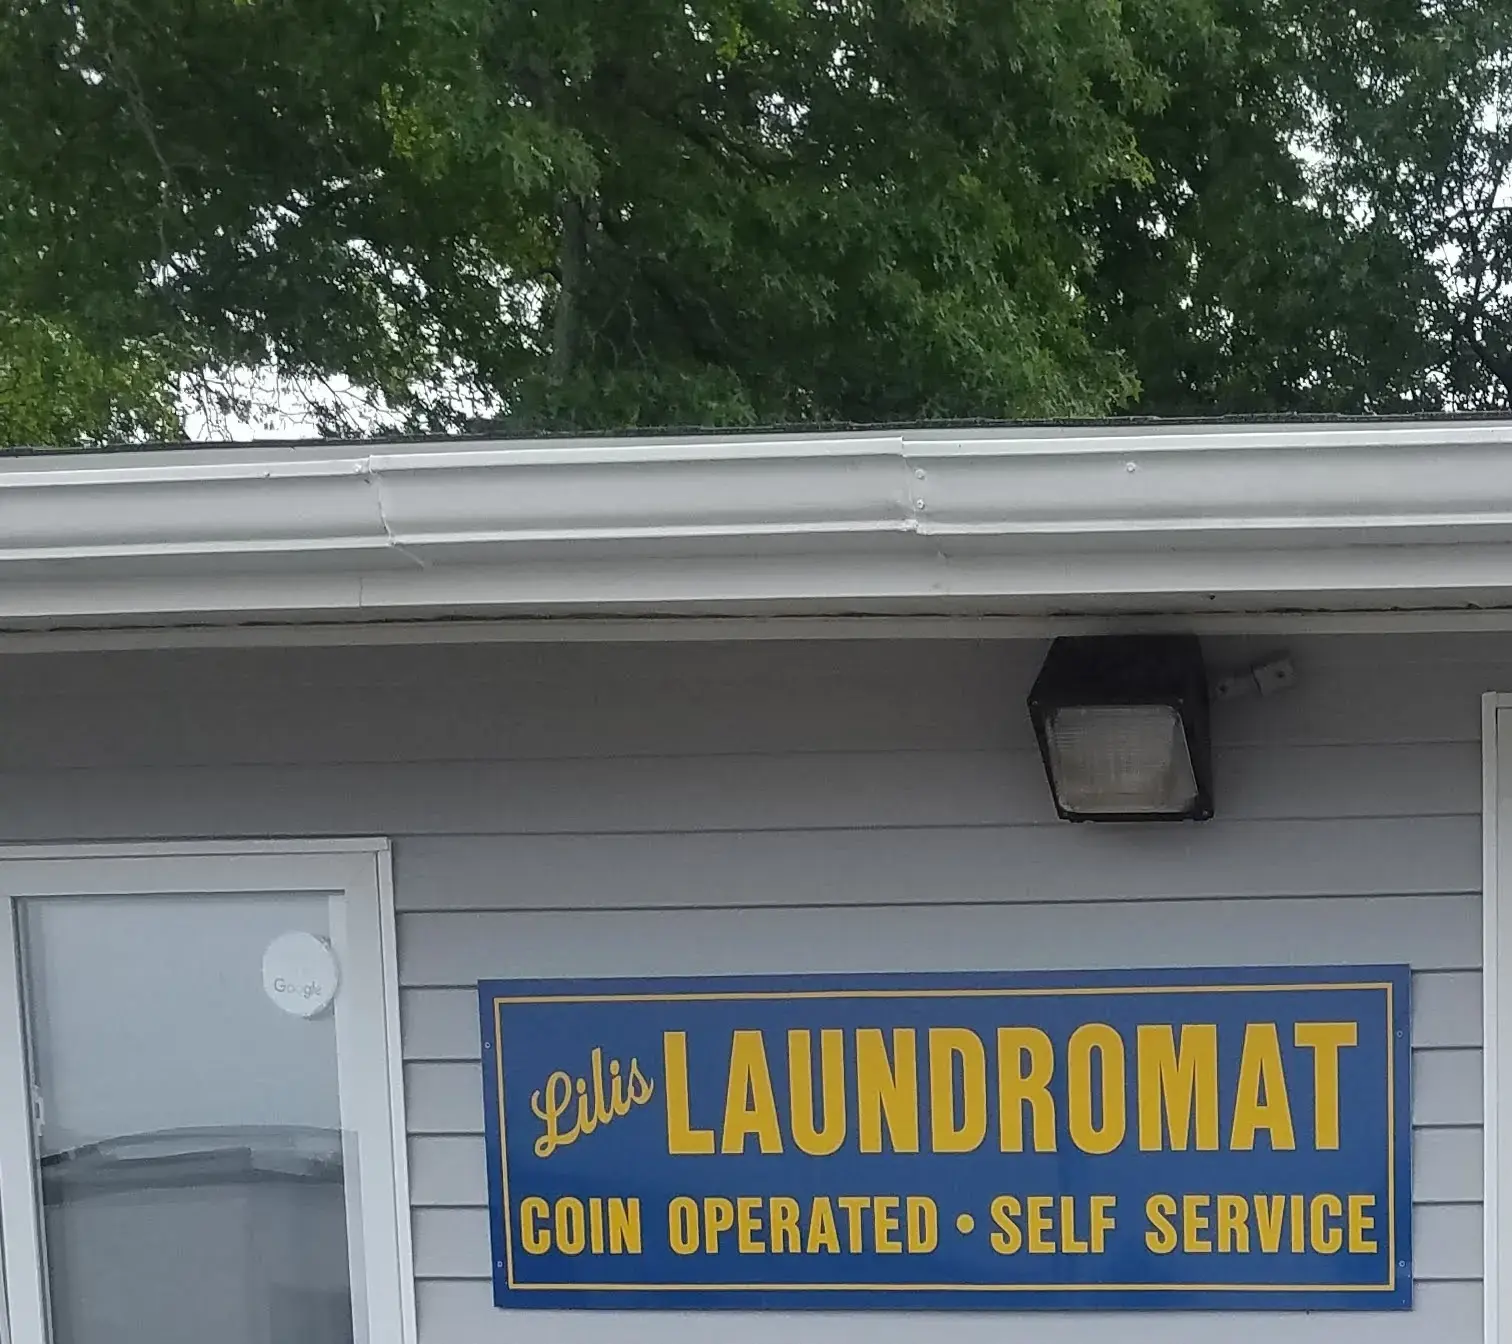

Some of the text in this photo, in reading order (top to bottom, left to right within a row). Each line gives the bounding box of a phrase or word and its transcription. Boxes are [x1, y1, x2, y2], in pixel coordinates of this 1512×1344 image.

[530, 1020, 1359, 1159] Lilis LAUNDROMAT
[519, 1193, 1379, 1256] COIN OPERATED SELF SERVICE
